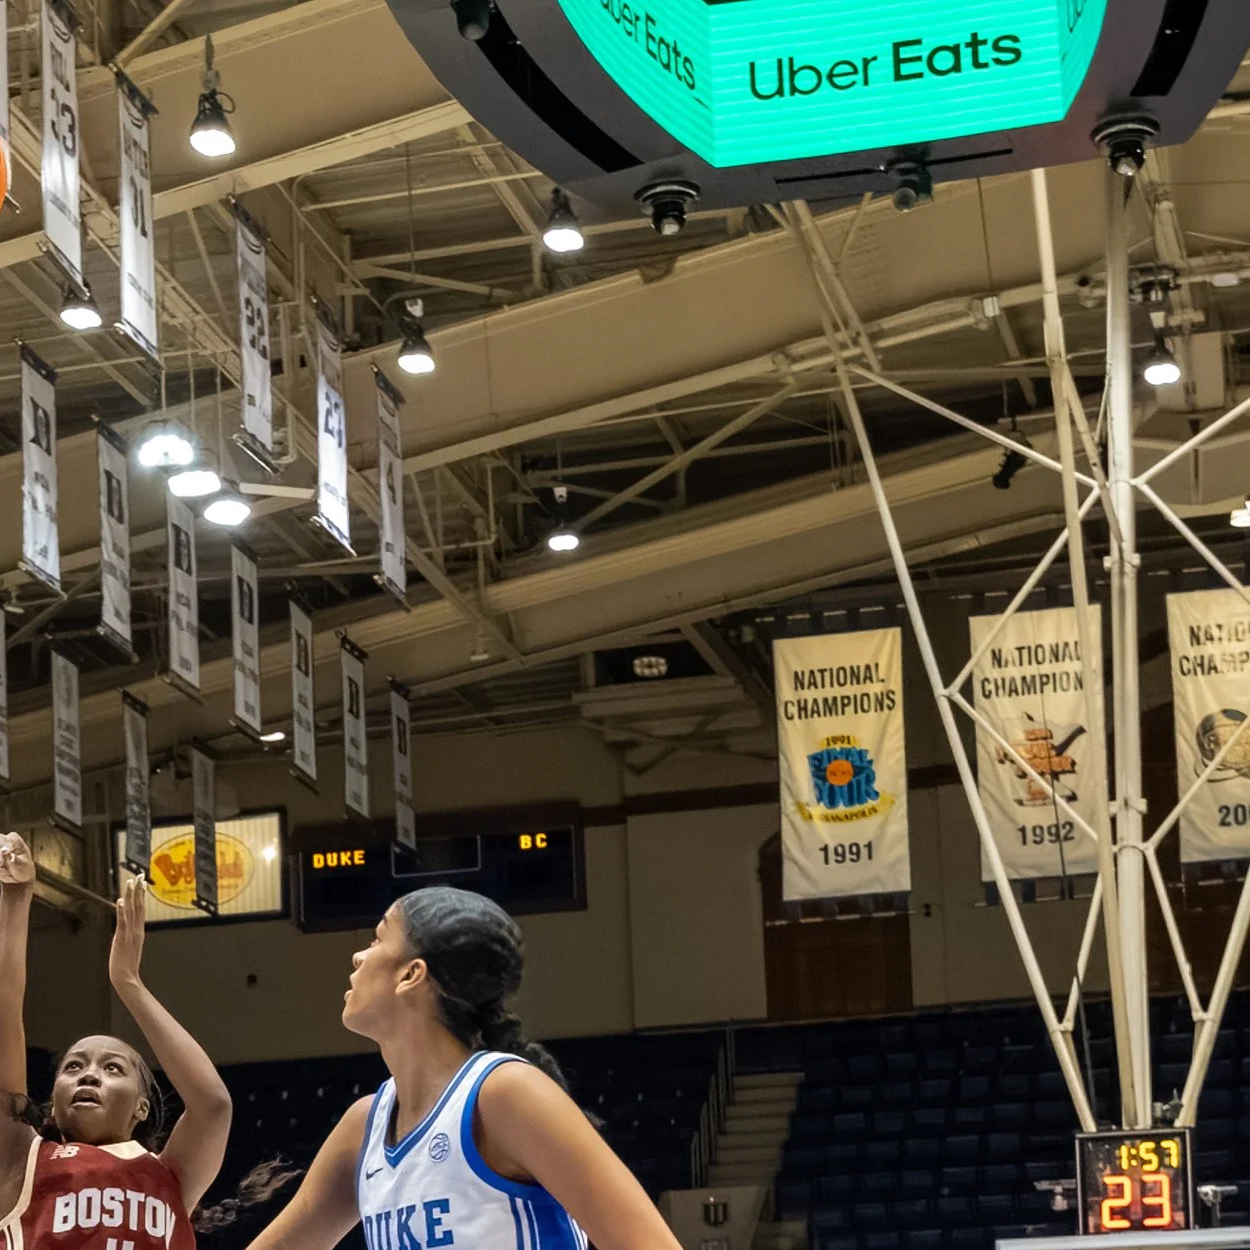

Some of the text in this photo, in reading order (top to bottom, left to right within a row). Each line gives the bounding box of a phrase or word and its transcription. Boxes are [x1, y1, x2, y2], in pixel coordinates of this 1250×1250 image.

[601, 0, 696, 90] ber Eats
[749, 32, 1022, 101] Uber Eats
[1189, 620, 1250, 647] NATIO
[794, 662, 885, 691] NATIONAL
[981, 671, 1084, 699] CHAMPION
[784, 690, 896, 720] CHAMPIONS
[1218, 803, 1250, 827] 20
[1017, 822, 1075, 846] 1992
[313, 849, 365, 869] DUKE
[820, 841, 874, 865] 1991
[1120, 1139, 1179, 1171] 1:57
[1101, 1173, 1172, 1230] 23
[53, 1187, 176, 1250] BOSTON
